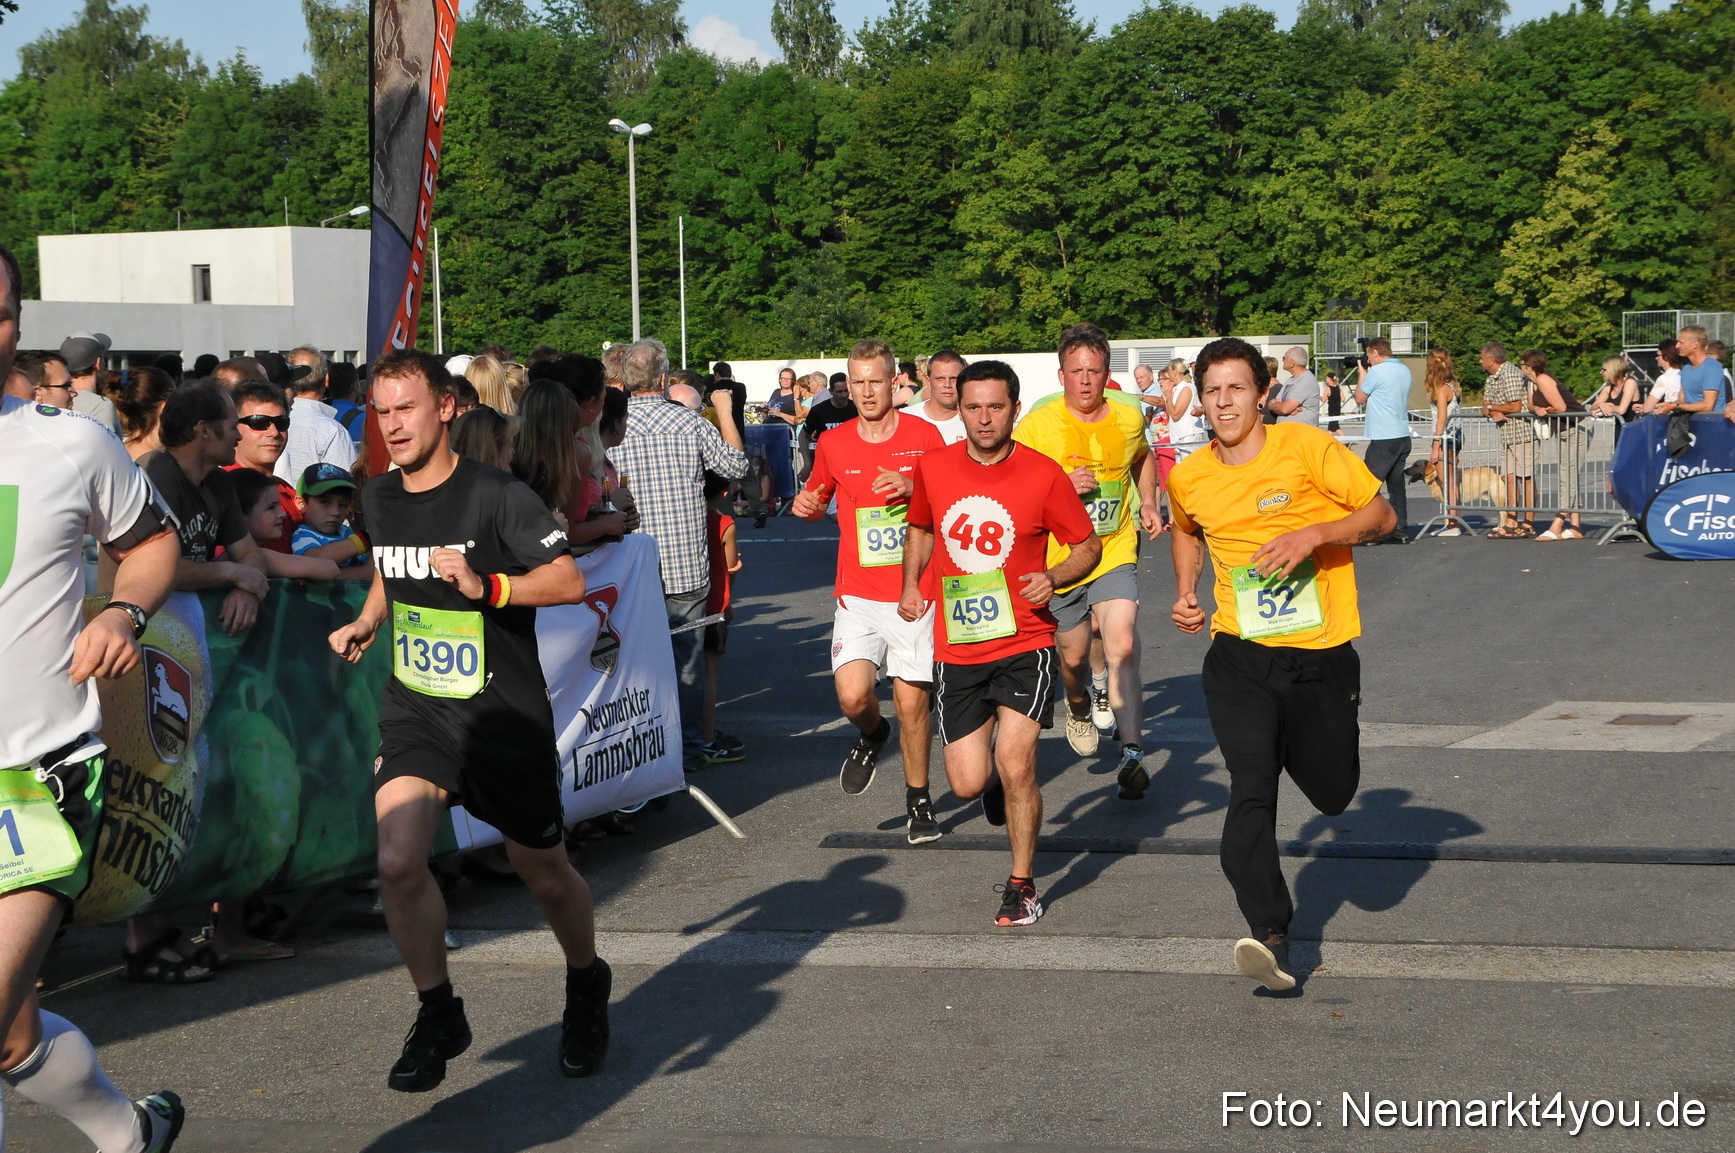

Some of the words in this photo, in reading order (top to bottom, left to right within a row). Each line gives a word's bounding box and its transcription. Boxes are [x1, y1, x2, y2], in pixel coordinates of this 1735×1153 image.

[1659, 458, 1732, 485] Fisch
[1697, 531, 1735, 541] AUTO
[953, 596, 999, 626] 459
[1257, 585, 1297, 619] 52
[397, 634, 478, 677] 1390
[578, 686, 650, 736] Neumarkter
[572, 718, 666, 792] Lammsbräu
